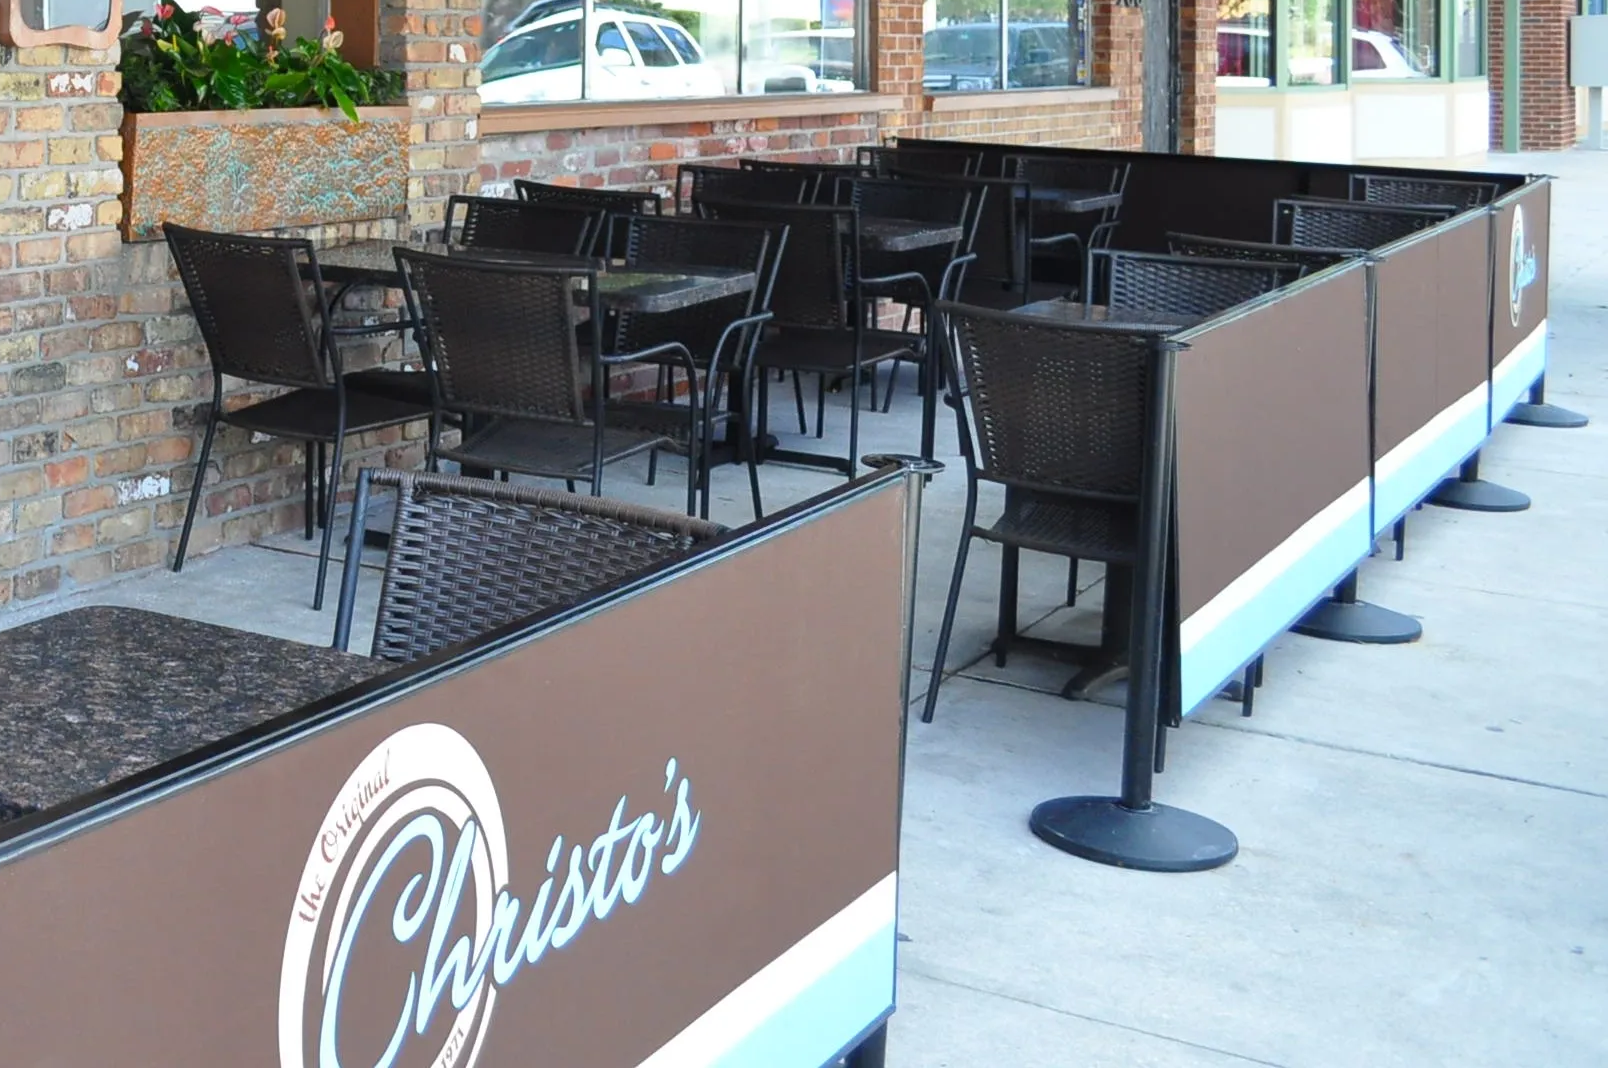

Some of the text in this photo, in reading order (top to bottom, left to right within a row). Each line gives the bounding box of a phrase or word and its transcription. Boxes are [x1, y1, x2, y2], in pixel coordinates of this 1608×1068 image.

[298, 748, 391, 923] the Original
[319, 756, 701, 1068] Christo's
